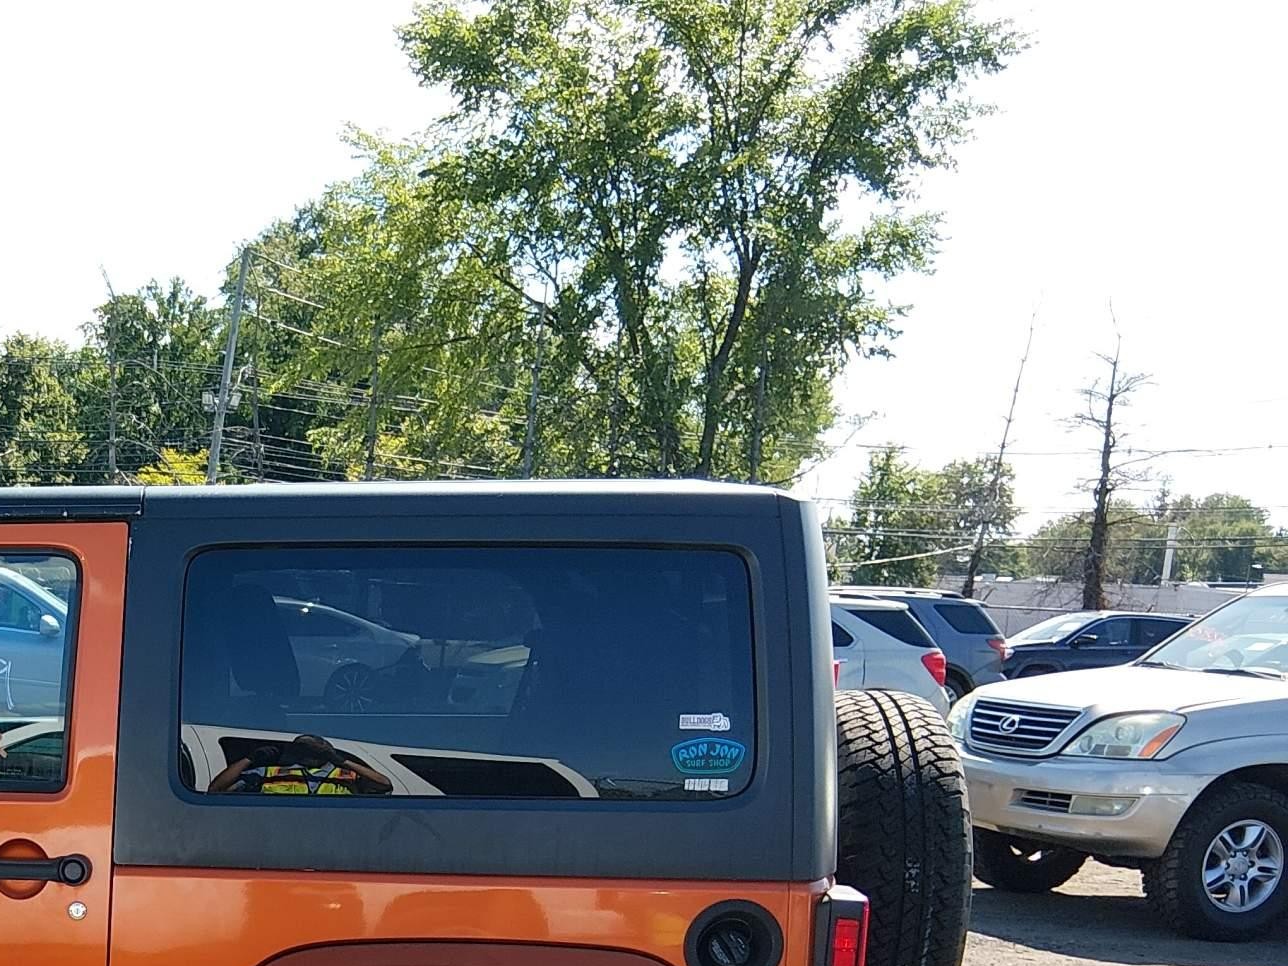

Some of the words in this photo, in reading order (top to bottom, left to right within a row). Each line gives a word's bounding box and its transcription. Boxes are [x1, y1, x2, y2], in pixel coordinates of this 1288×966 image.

[679, 743, 708, 761] RON
[687, 759, 705, 767] SURF
[709, 759, 730, 767] SHOP
